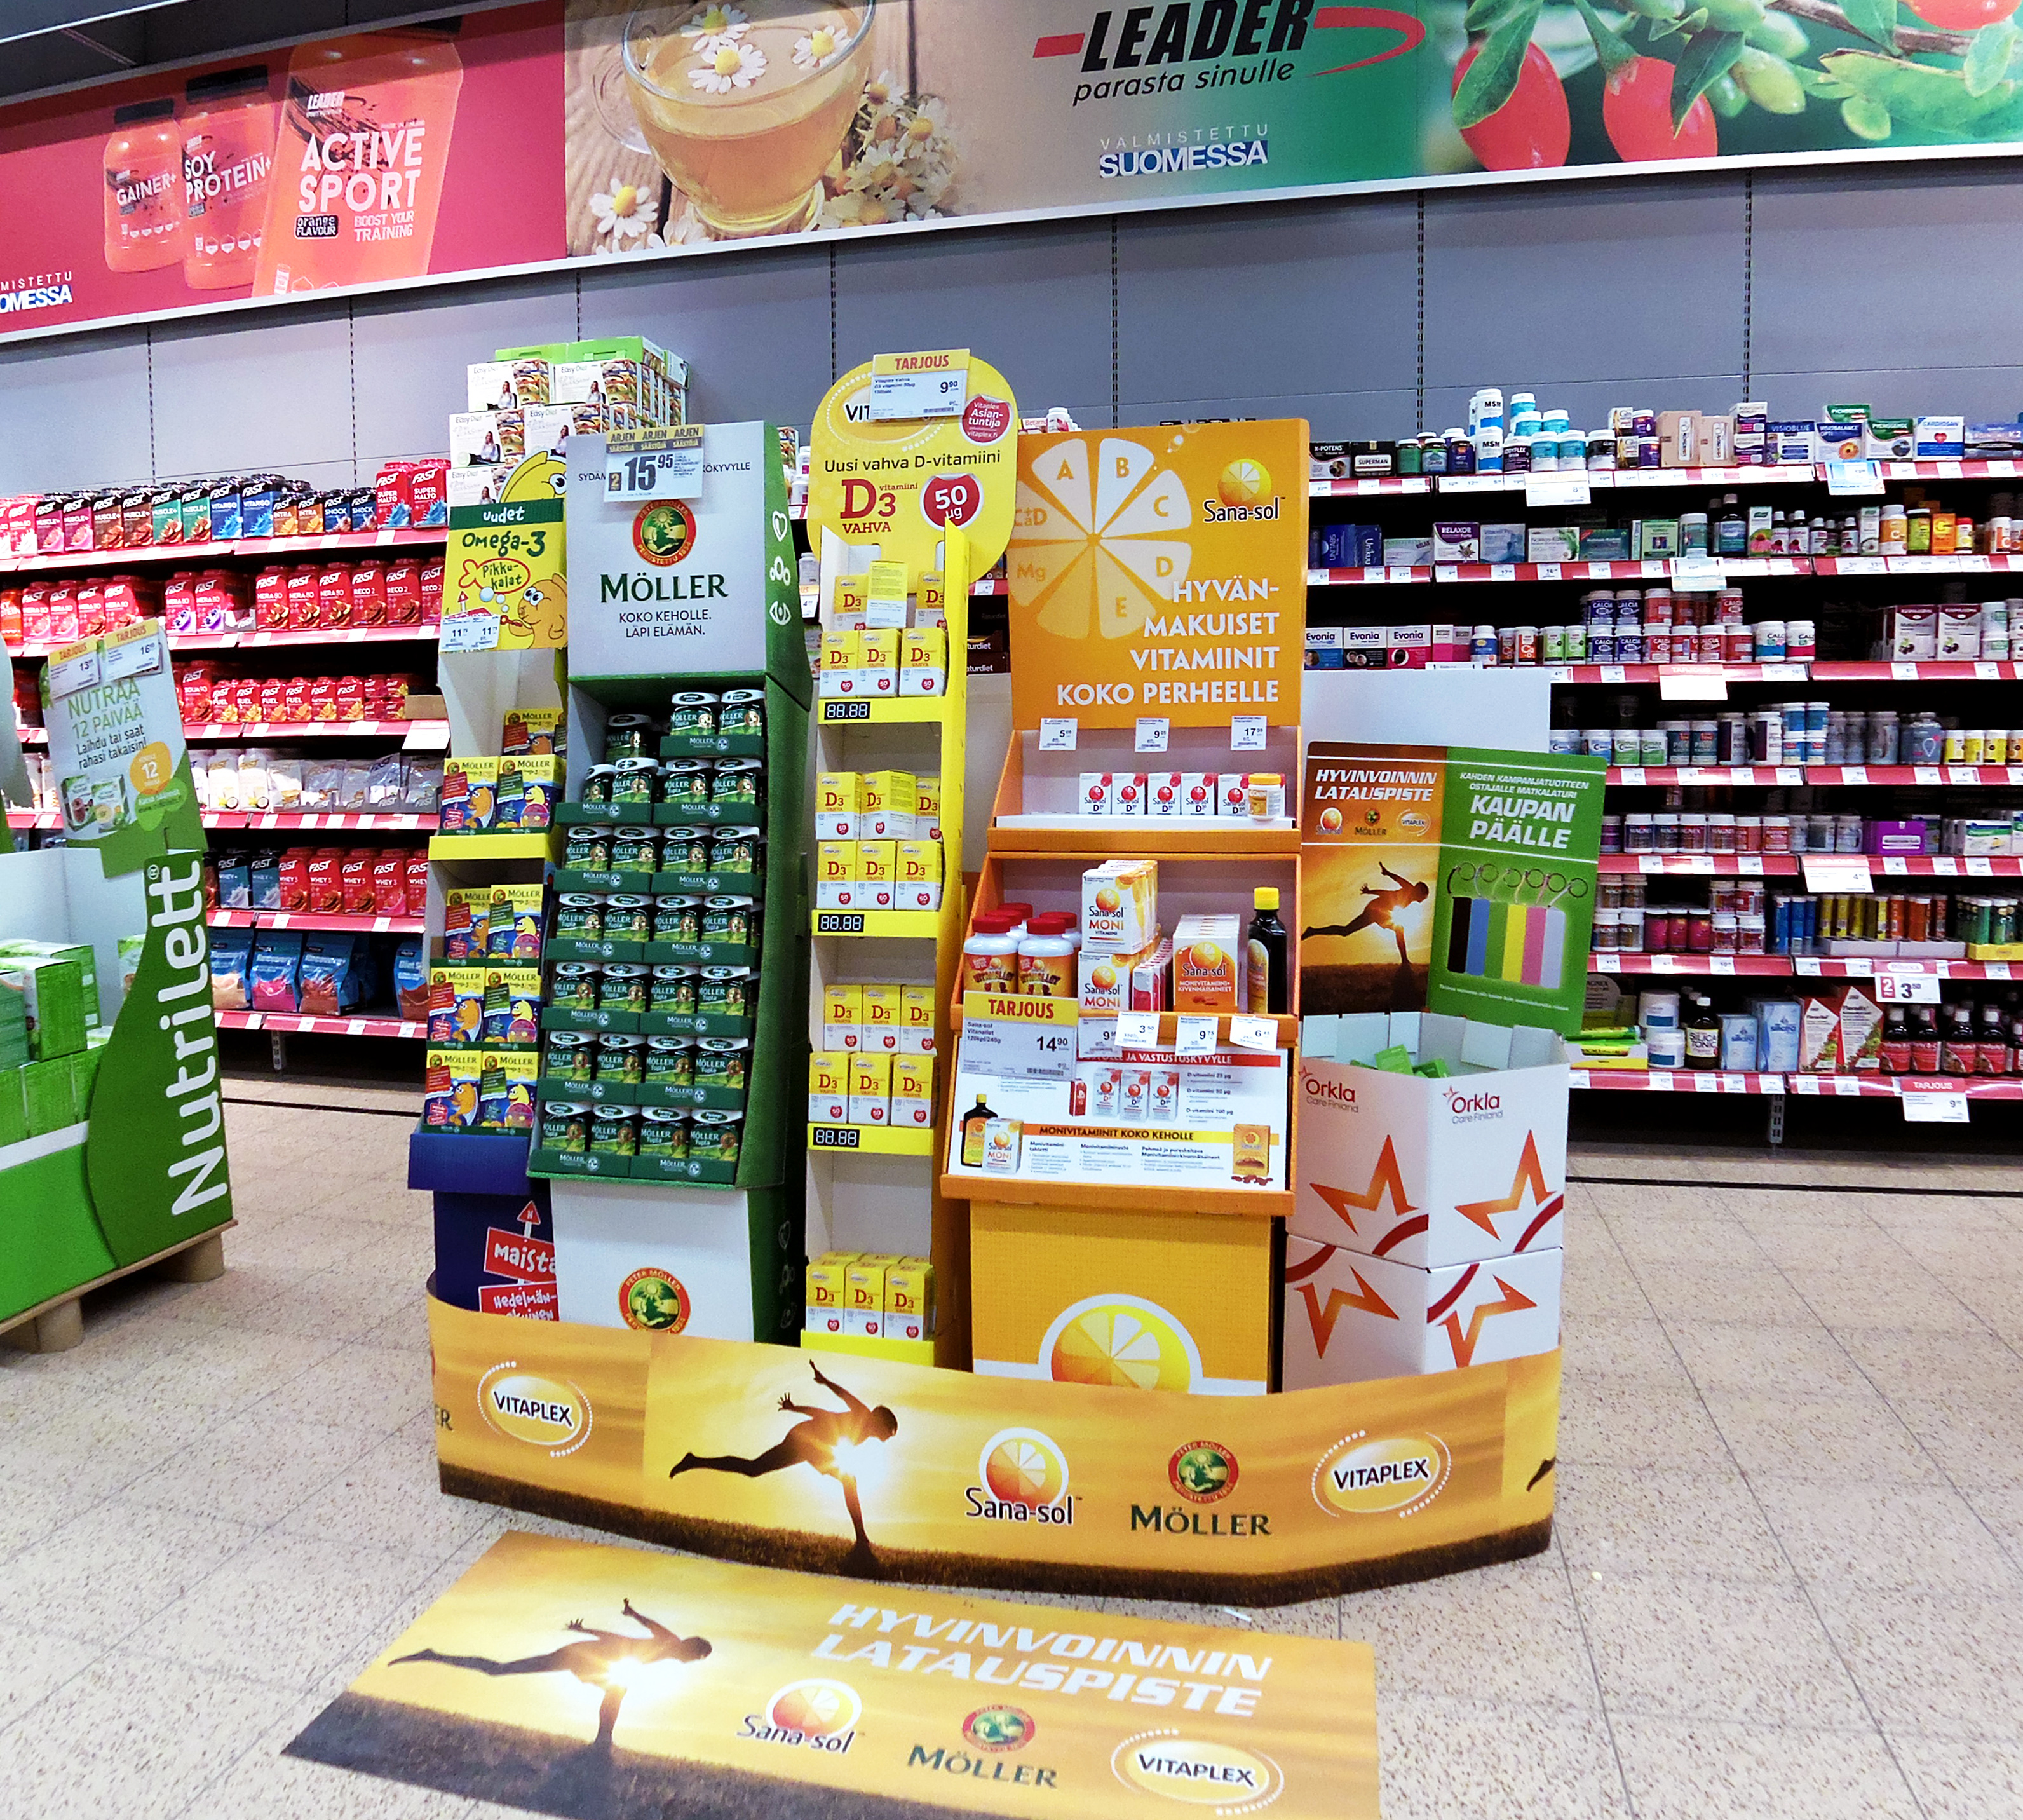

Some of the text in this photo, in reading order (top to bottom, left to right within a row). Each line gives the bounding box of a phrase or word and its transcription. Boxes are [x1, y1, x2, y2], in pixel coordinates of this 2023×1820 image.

[1081, 0, 1315, 72] LEADER
[1073, 59, 1294, 105] parasta sinulle
[307, 92, 344, 111] LEADER
[1101, 124, 1268, 150] VALMISTETTU
[301, 128, 425, 172] ACTIVE
[1099, 140, 1268, 179] SUOMESSA
[185, 151, 217, 181] SOY
[299, 171, 421, 214] SPORT
[354, 211, 415, 228] BOOST YOUR
[297, 224, 337, 237] FLAVOUR
[354, 224, 414, 242] TRAINING
[895, 355, 949, 370] TARJOUS
[968, 418, 1001, 428] tuntija
[611, 427, 699, 443] ARJEN ARJEN ARJEN
[825, 451, 1001, 472] Uusi vahva D-vitamiini
[879, 483, 918, 491] vitamiini
[1056, 458, 1169, 517] A B C
[935, 486, 968, 510] 50
[1203, 496, 1280, 522] Sana-sol
[842, 522, 891, 534] VAHVA
[462, 530, 546, 557] Omega-3
[1156, 557, 1174, 577] D
[600, 573, 729, 604] MÖLLER
[1173, 575, 1280, 603] HYVÄN-
[619, 609, 712, 623] KOKO KEHOLLE.
[1115, 597, 1127, 618] E
[626, 625, 652, 638] LÄPI
[1144, 612, 1280, 638] MAKUISET
[1306, 630, 1423, 641] Evonia Evonia Evonia
[1130, 647, 1280, 671] VITAMIINIT
[1057, 681, 1279, 706] KOKO PERHEELLE
[72, 720, 89, 739] 12
[76, 724, 145, 756] Laihdu tai saat
[78, 753, 106, 770] rahasi
[1315, 769, 1437, 785] HYVINVOINNIN
[1460, 773, 1590, 789] KAHDEN KAMPANJATUOTTEEN
[1315, 785, 1434, 801] LATAUSPISTE
[1469, 784, 1577, 799] OSTAJALLE MATKALATURI
[1470, 795, 1576, 822] KAUPAN
[1470, 818, 1571, 849] PÄÄLLE
[1089, 906, 1125, 918] Sana-sol
[1089, 919, 1124, 931] MONI
[1183, 963, 1226, 977] Sana-sol
[1085, 982, 1120, 995] Sana-sol
[989, 999, 1055, 1019] TARJOUS
[1085, 996, 1120, 1007] MONI
[1306, 1079, 1500, 1113] Orkla Orkla
[1452, 1114, 1473, 1124] Care
[1474, 1110, 1503, 1122] Finland
[1121, 1130, 1149, 1138] KOKO
[1152, 1131, 1194, 1141] KEHOLLE
[493, 1390, 572, 1428] VITAPLEX
[964, 1458, 1431, 1537] Sana-sol MÖLLER VITAPLEX
[826, 1604, 1273, 1681] HYVINVOINNIN
[811, 1633, 1263, 1718] LATAUSPISTE
[736, 1714, 1257, 1791] Sana-sol MÖLLER VITAPLEX
